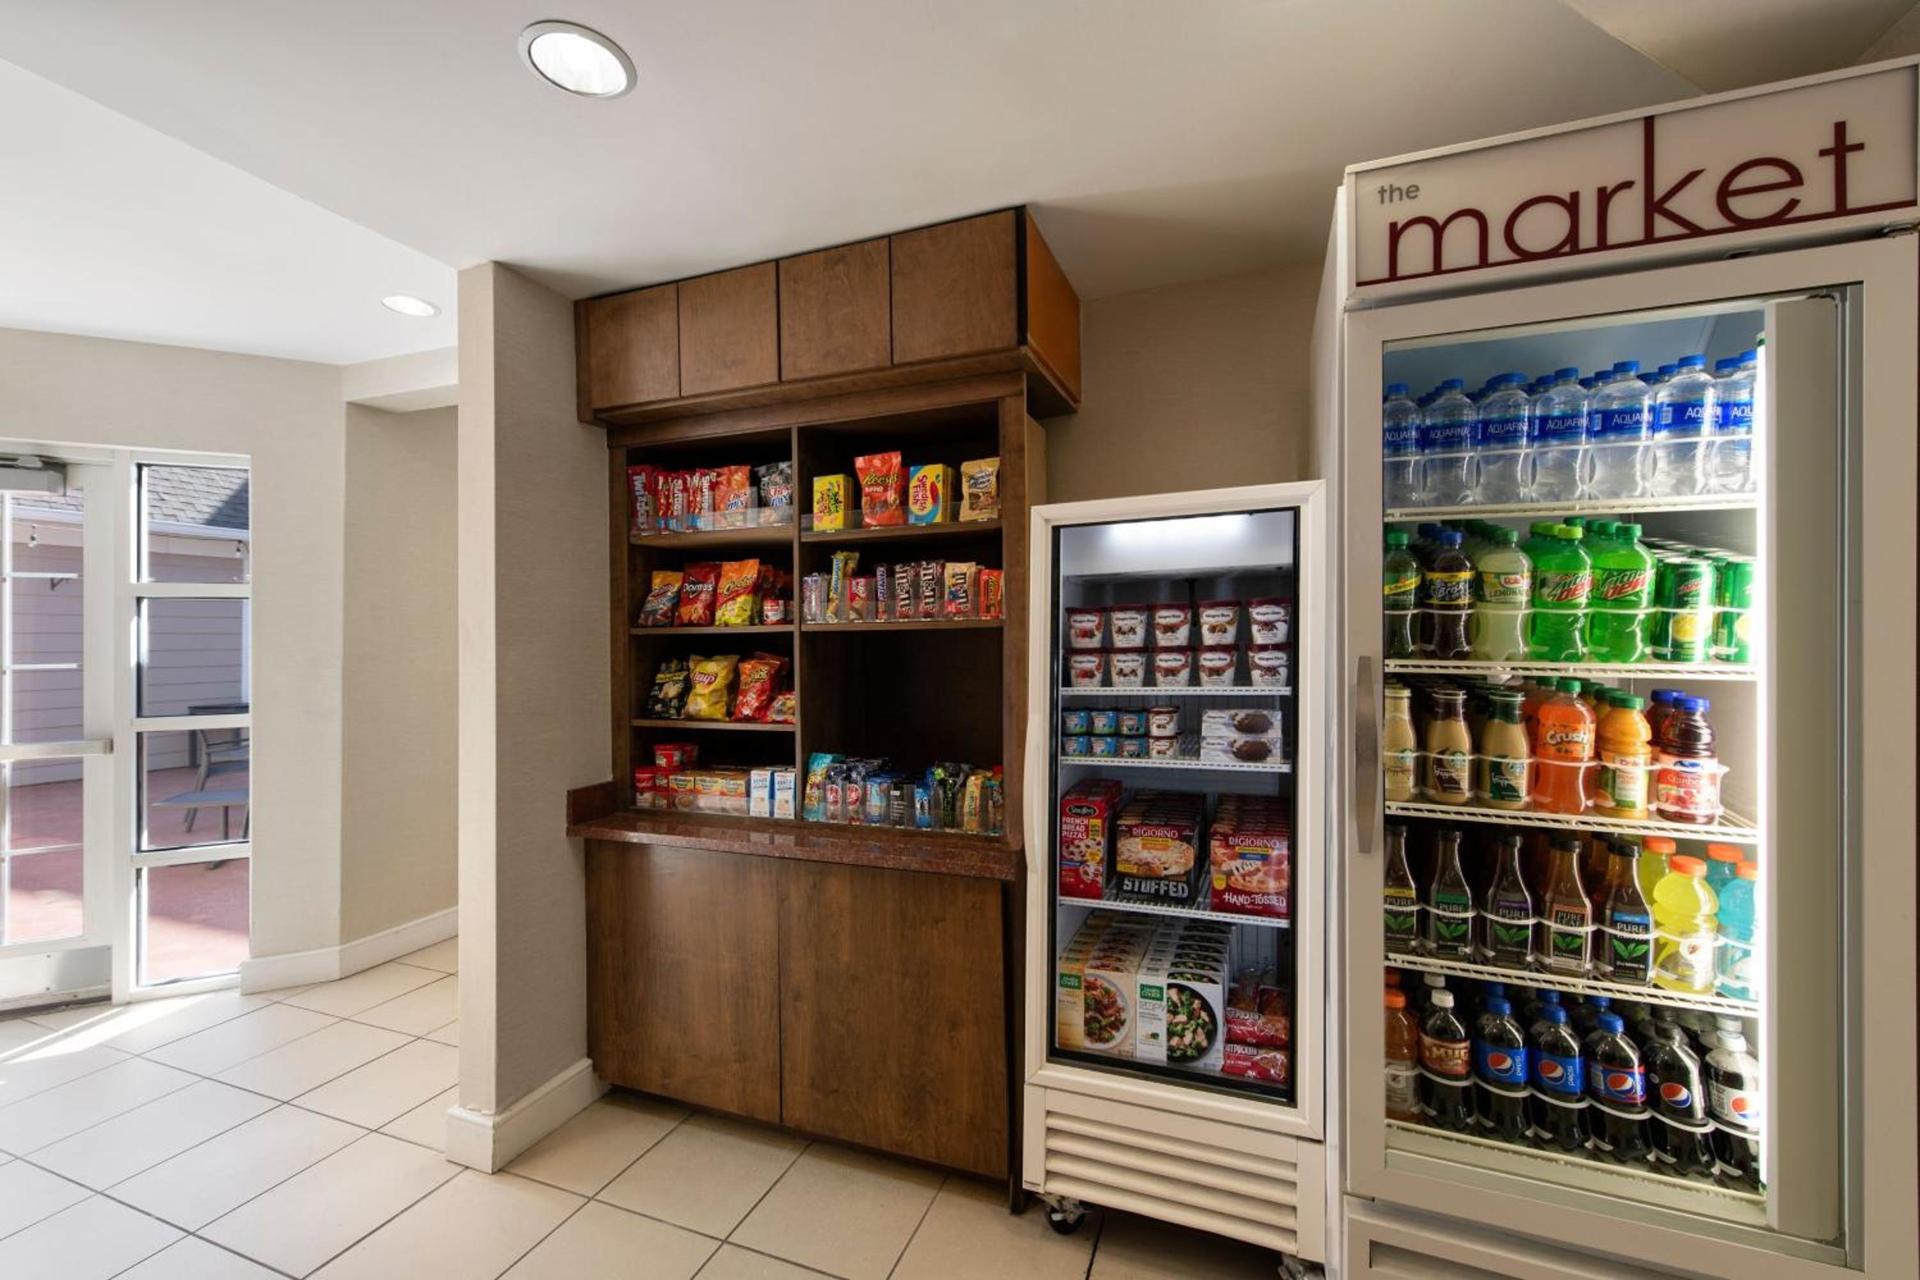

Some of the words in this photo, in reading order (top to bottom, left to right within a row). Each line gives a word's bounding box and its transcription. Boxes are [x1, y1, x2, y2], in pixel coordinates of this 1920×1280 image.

[1378, 180, 1421, 206] the
[1388, 115, 1866, 281] market
[912, 485, 920, 505] Fish
[917, 474, 928, 512] Swedish
[1547, 729, 1589, 745] Crush
[1062, 831, 1087, 840] PIZZAS
[1123, 877, 1189, 898] STUFFED
[1617, 922, 1646, 933] PURE
[1567, 1065, 1576, 1088] pepsi
